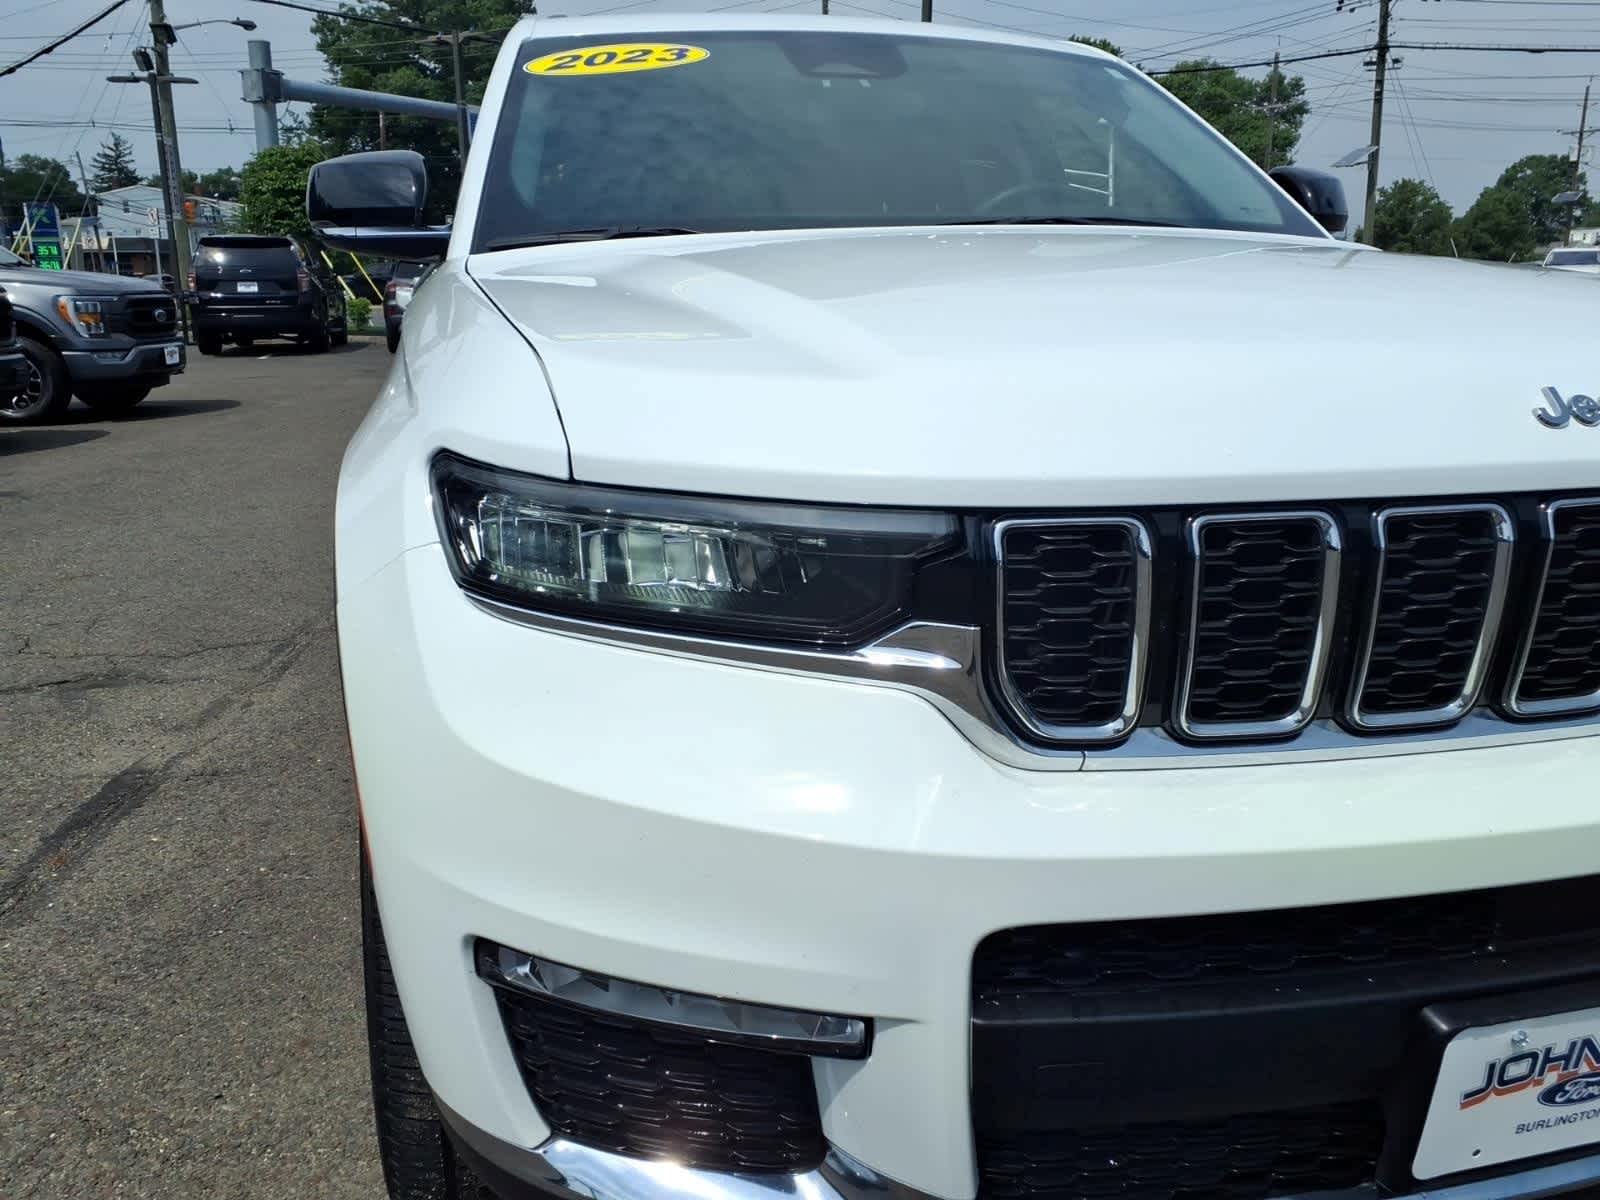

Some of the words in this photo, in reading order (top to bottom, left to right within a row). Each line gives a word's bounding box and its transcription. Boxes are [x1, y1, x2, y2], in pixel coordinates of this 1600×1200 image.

[544, 48, 689, 71] 2023
[1532, 386, 1600, 429] Je
[1554, 1076, 1600, 1103] For
